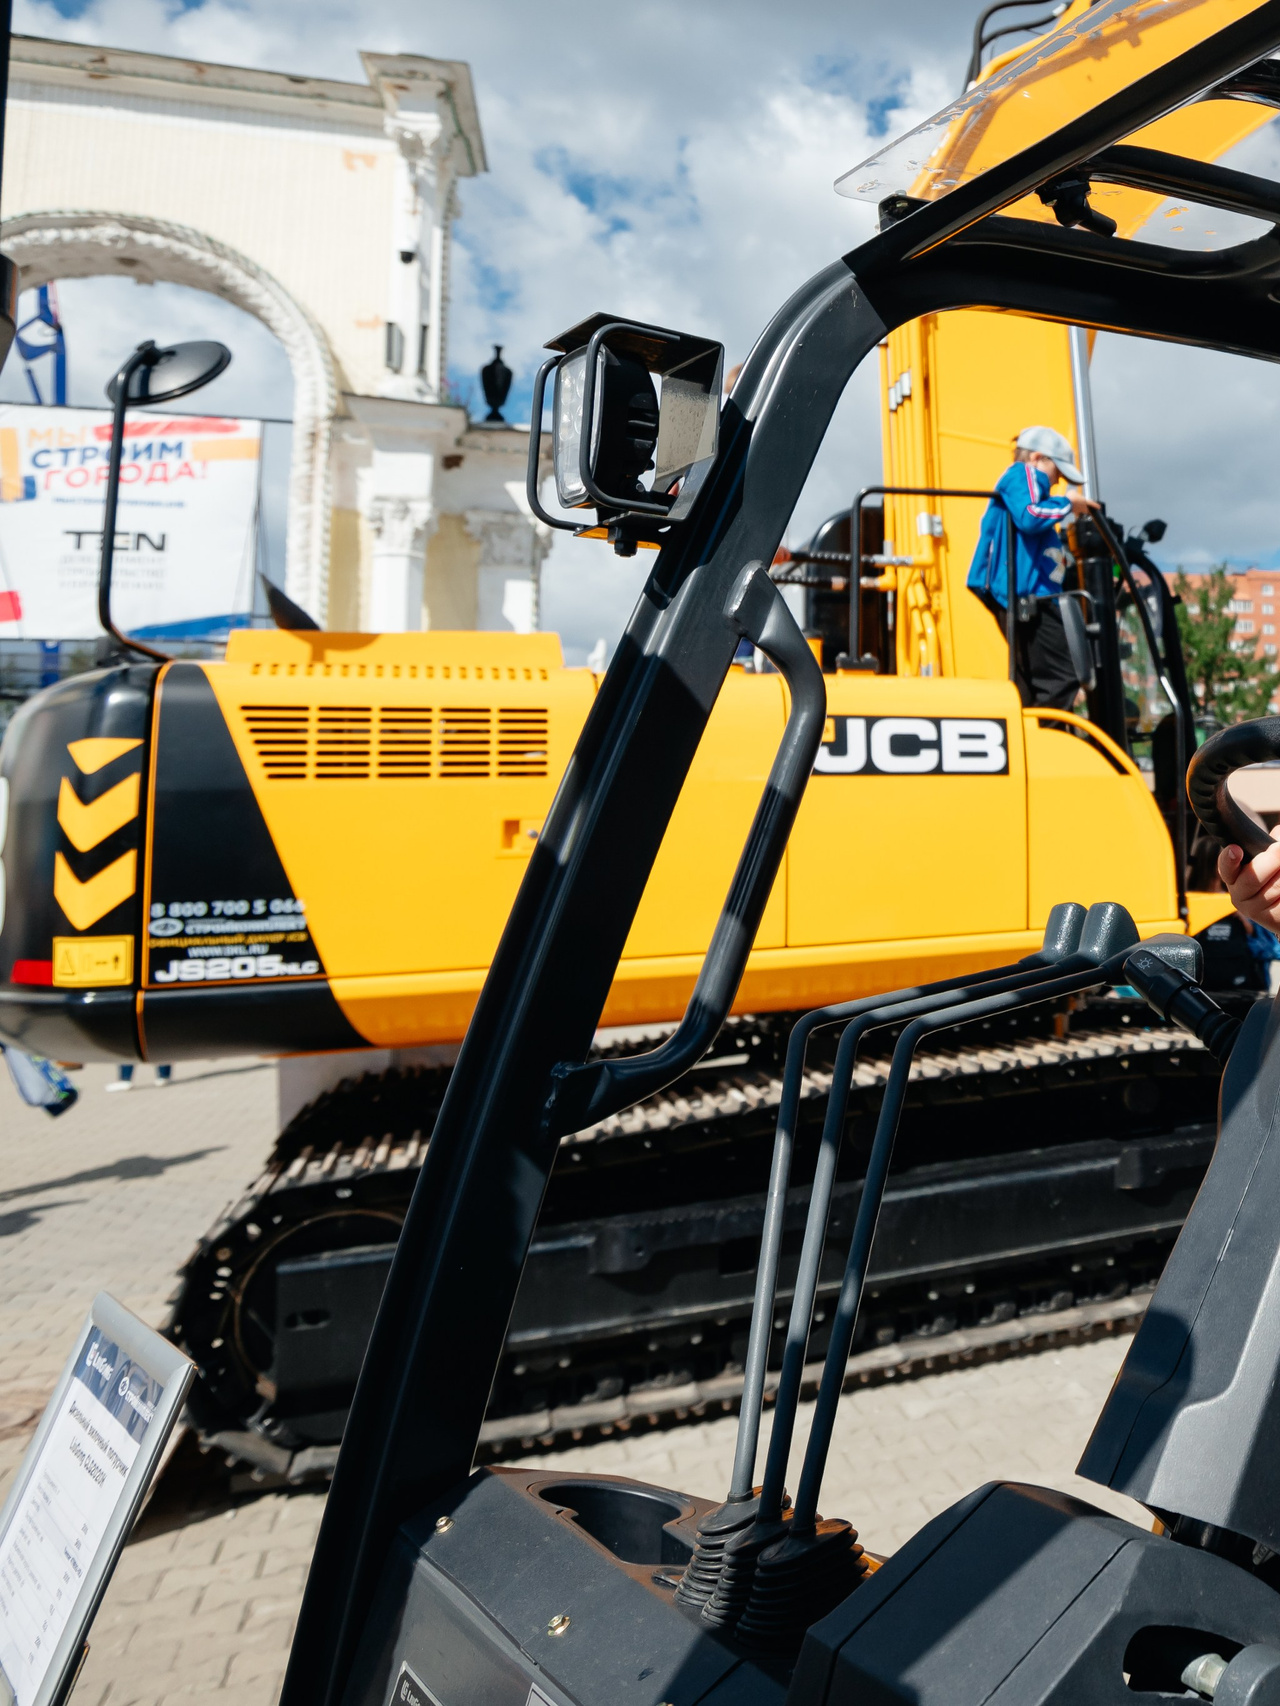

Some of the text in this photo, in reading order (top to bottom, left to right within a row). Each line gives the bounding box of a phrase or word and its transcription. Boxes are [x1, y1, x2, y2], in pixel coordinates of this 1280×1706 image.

[28, 426, 87, 446] МЫ
[813, 718, 1007, 773] JCB
[168, 901, 208, 917] 800
[211, 900, 250, 916] 700
[252, 899, 267, 915] 5
